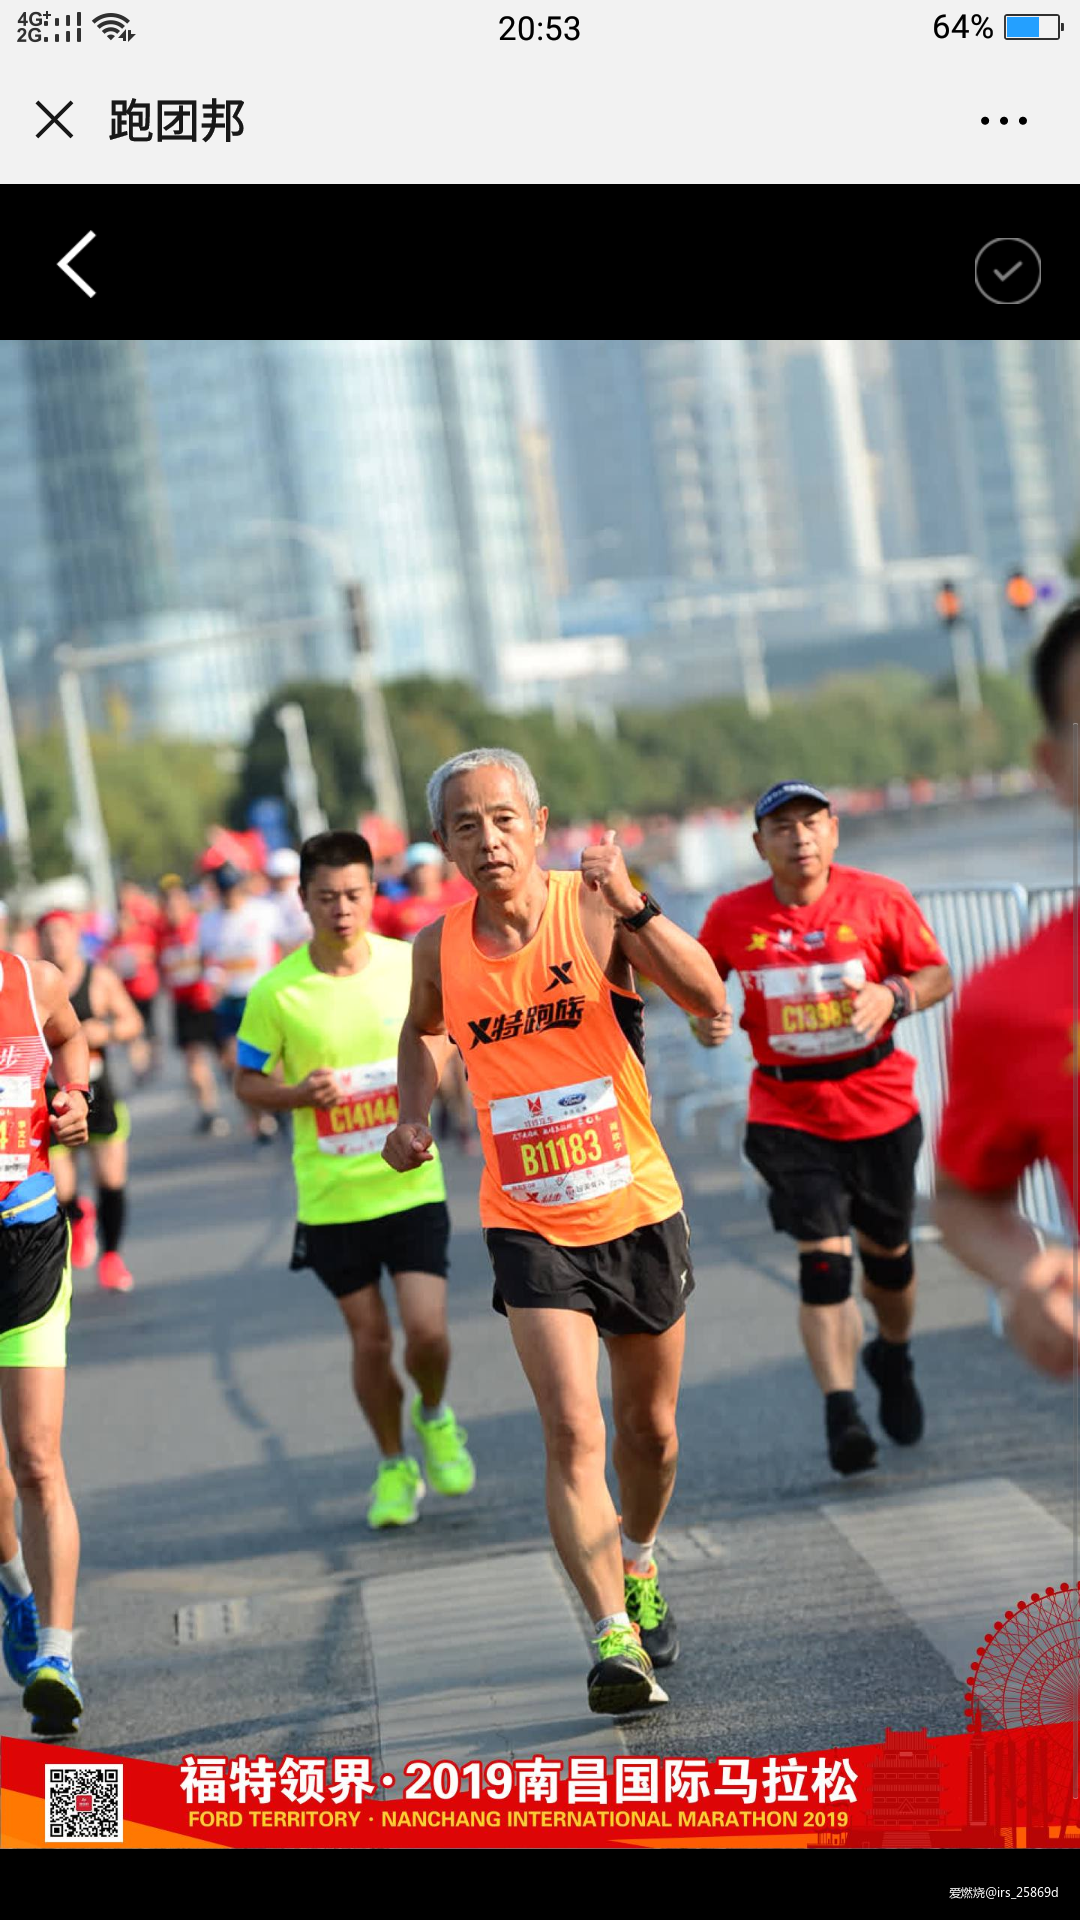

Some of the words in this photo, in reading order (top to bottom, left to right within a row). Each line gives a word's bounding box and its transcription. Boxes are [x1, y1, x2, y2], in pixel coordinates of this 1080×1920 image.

[16, 27, 42, 43] 2G
[498, 15, 581, 42] 20:53
[933, 13, 994, 40] 64%
[108, 97, 246, 143] 跑团邦
[520, 1129, 602, 1176] B11183
